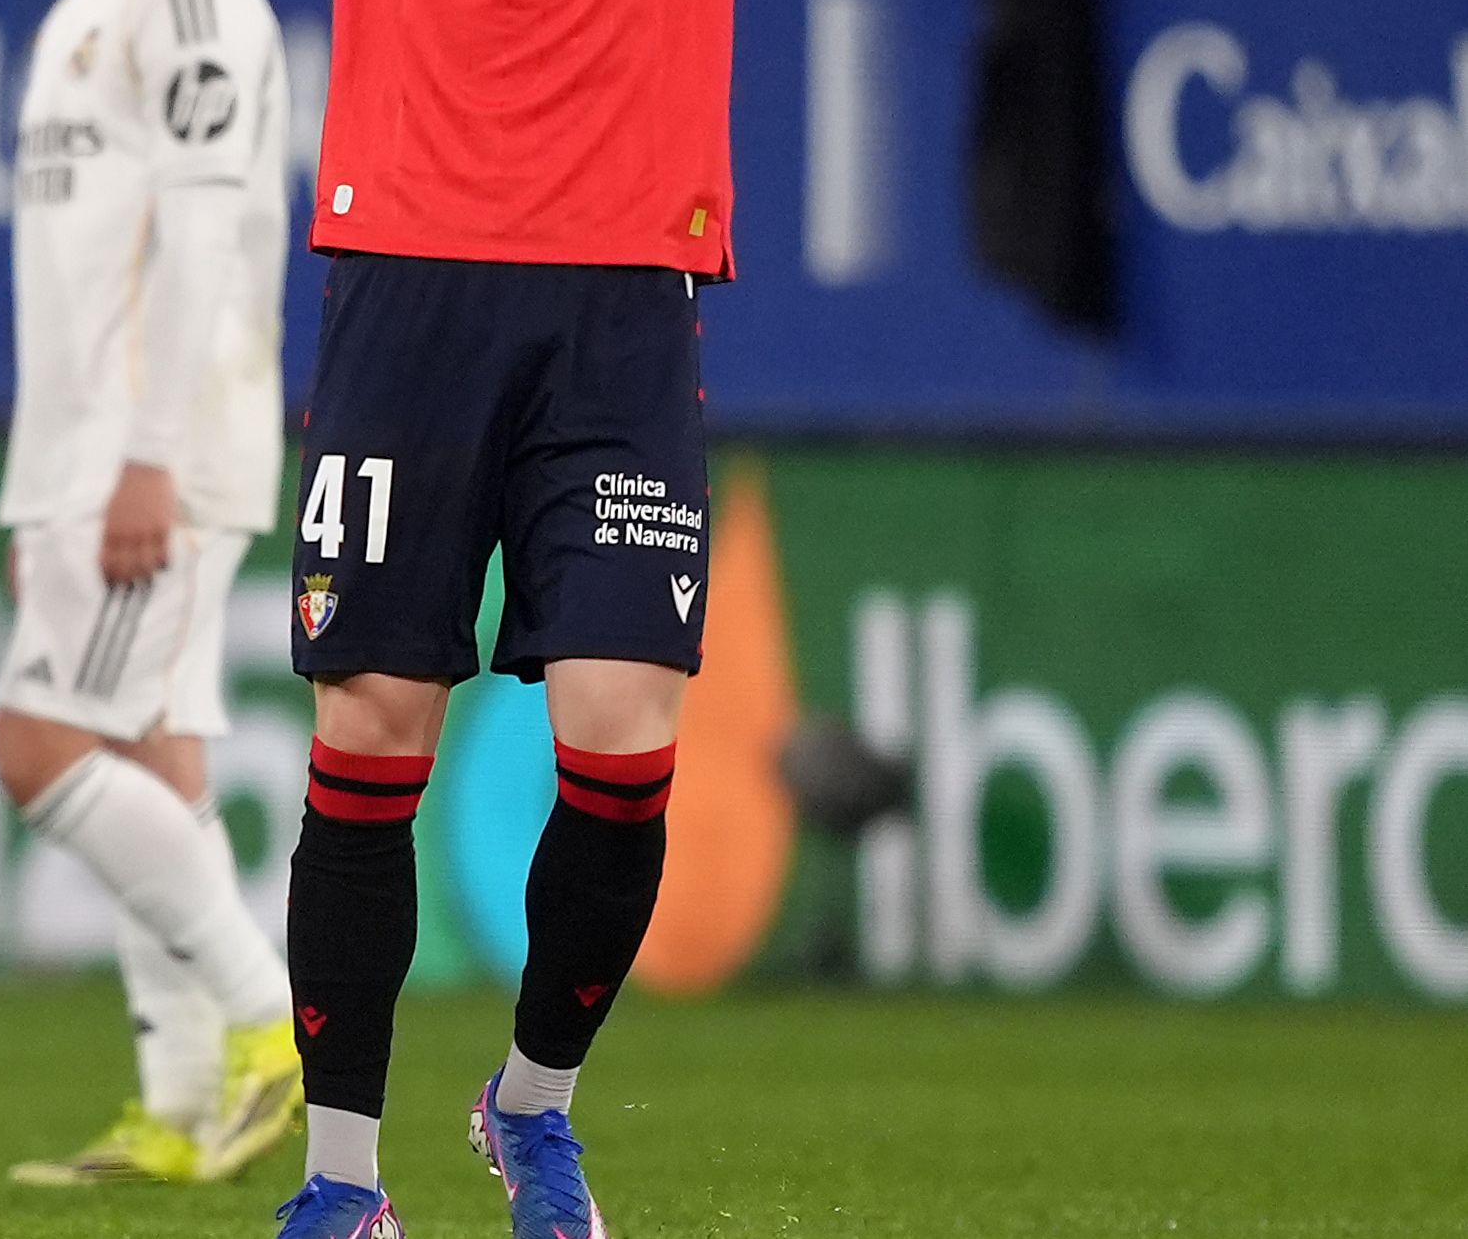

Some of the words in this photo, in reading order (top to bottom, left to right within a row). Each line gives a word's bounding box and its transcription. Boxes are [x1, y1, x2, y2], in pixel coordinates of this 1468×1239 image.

[594, 473, 666, 497] Clínica
[300, 454, 393, 563] 41
[594, 499, 703, 531] Universidad
[594, 523, 619, 546] de
[625, 524, 699, 555] Navarra
